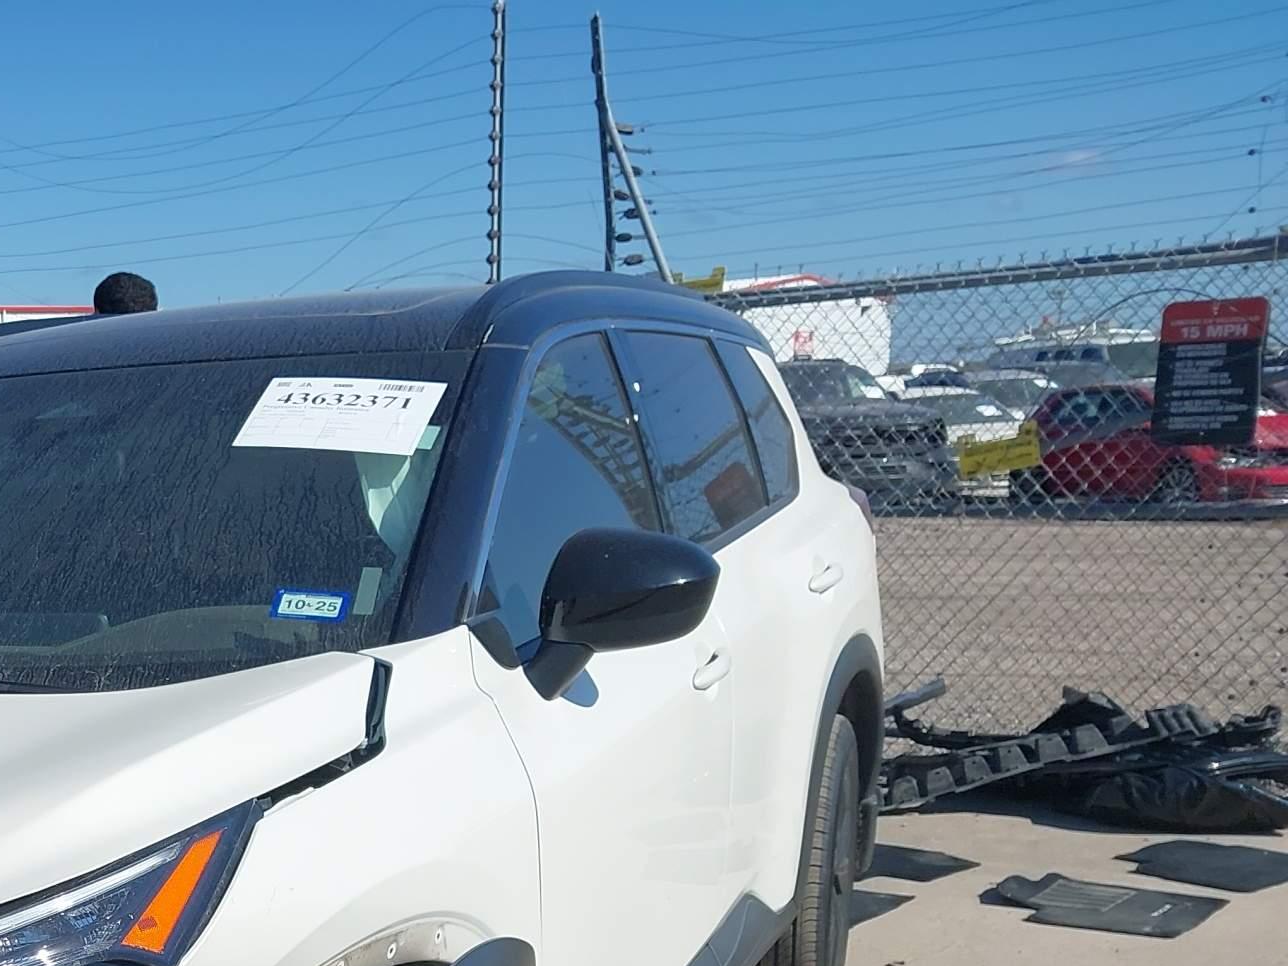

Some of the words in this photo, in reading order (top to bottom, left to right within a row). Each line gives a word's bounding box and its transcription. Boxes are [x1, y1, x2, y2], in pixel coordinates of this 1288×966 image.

[1181, 326, 1201, 339] 15
[1206, 323, 1249, 338] MPH
[276, 391, 414, 410] 43632371
